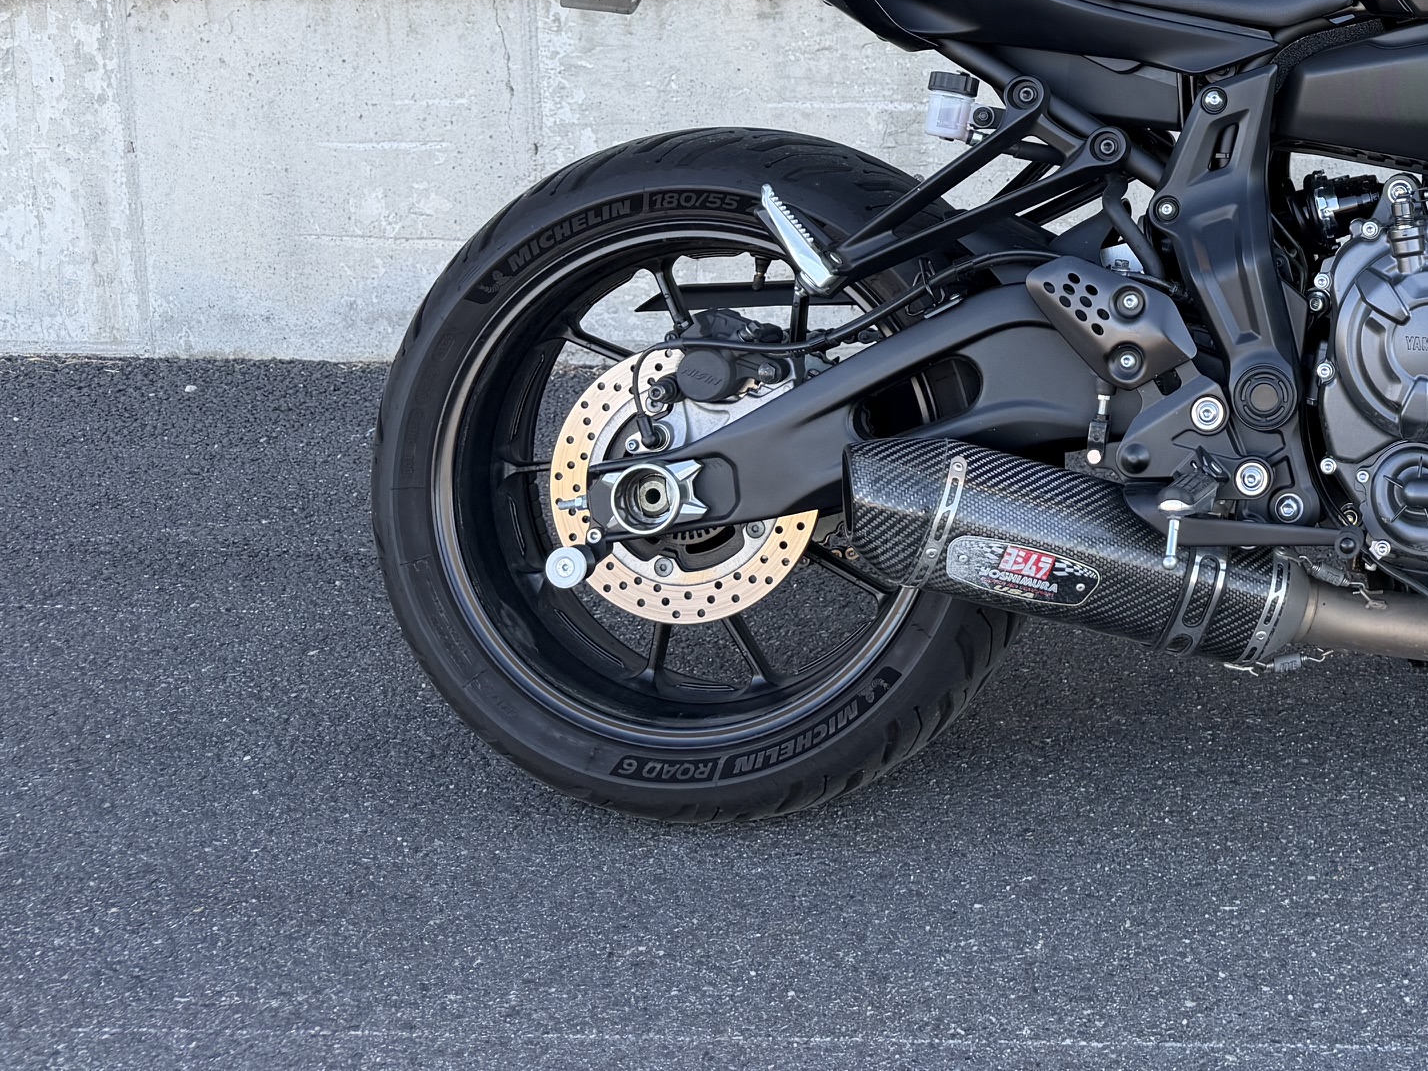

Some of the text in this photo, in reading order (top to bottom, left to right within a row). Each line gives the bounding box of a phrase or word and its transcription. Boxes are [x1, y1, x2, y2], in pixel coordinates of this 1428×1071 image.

[508, 199, 631, 272] MICHELIN
[651, 192, 740, 210] 180/55
[979, 566, 1058, 593] YOSHIMURA
[999, 547, 1054, 580] ヨシムラ
[994, 584, 1034, 599] USA
[618, 699, 858, 779] MICHELIN ROAD 6
